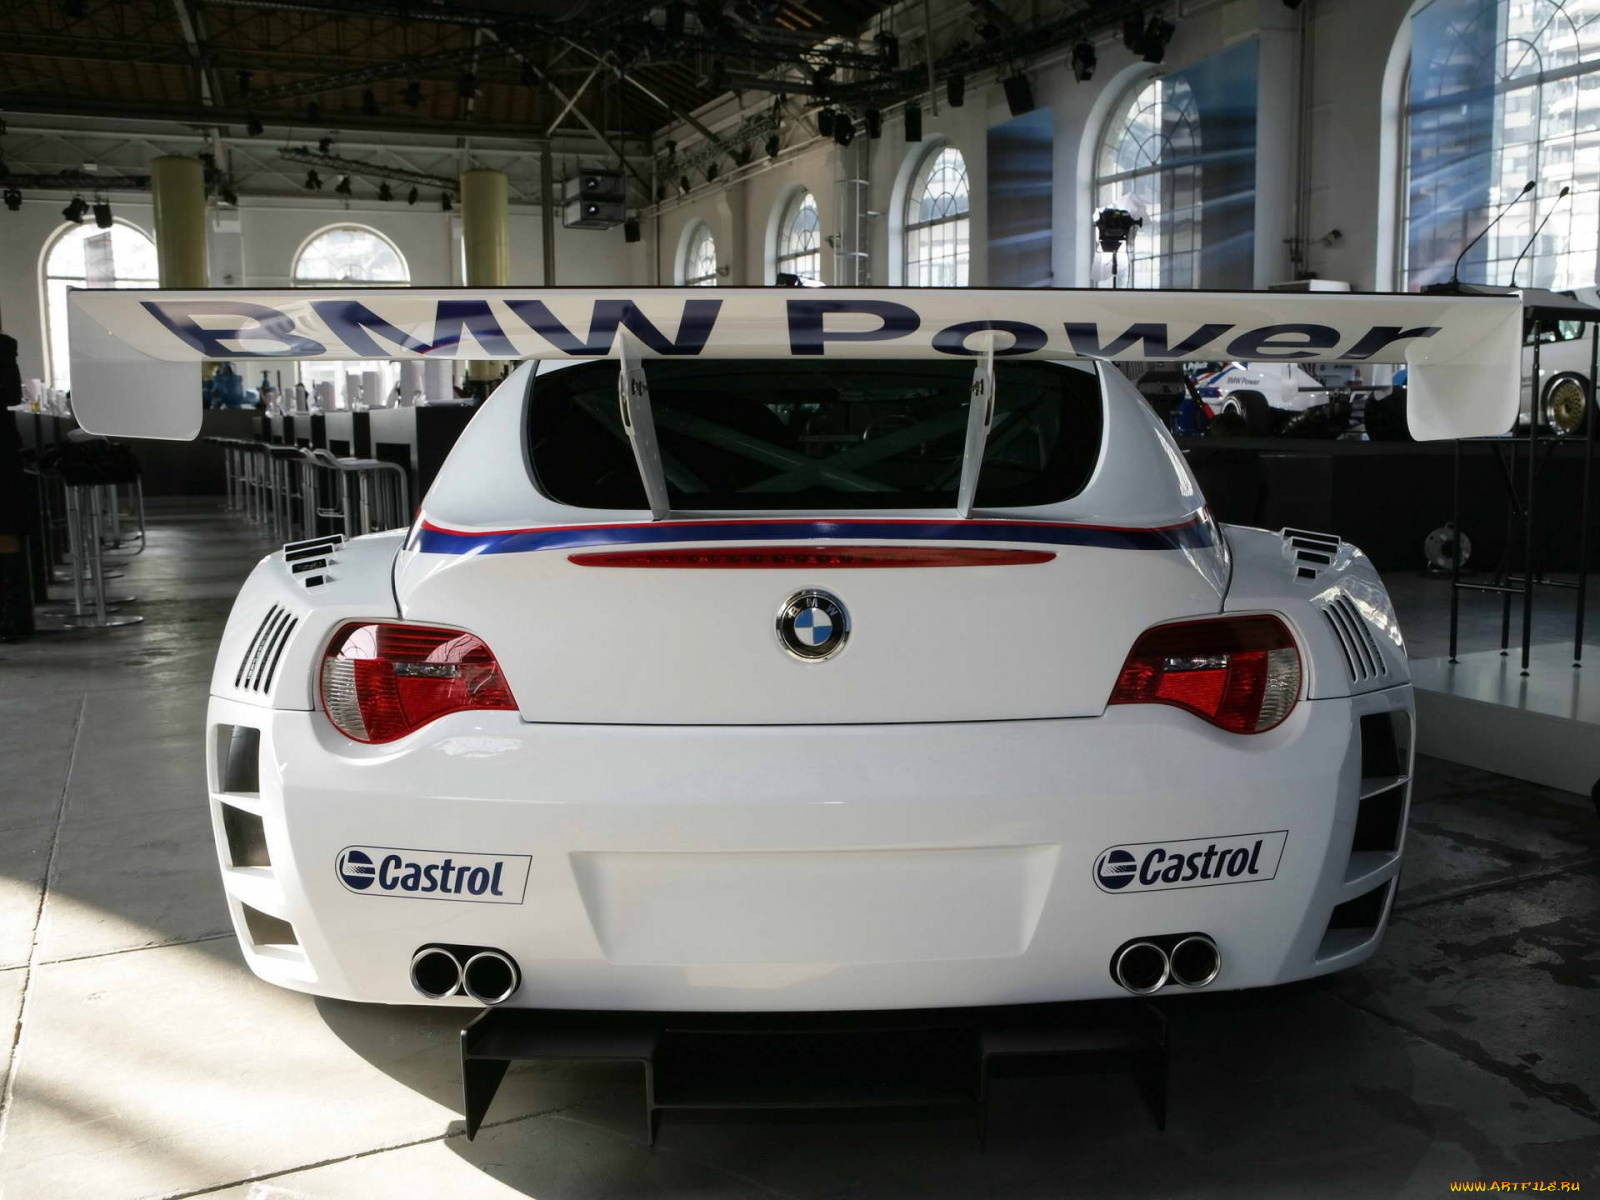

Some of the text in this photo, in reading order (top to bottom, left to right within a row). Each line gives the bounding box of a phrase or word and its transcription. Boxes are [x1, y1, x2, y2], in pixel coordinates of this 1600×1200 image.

[139, 299, 1443, 361] BMW Power
[1227, 376, 1260, 386] BMW Power
[787, 597, 839, 619] BMW
[378, 854, 504, 897] Castrol
[1139, 839, 1263, 886] Castrol
